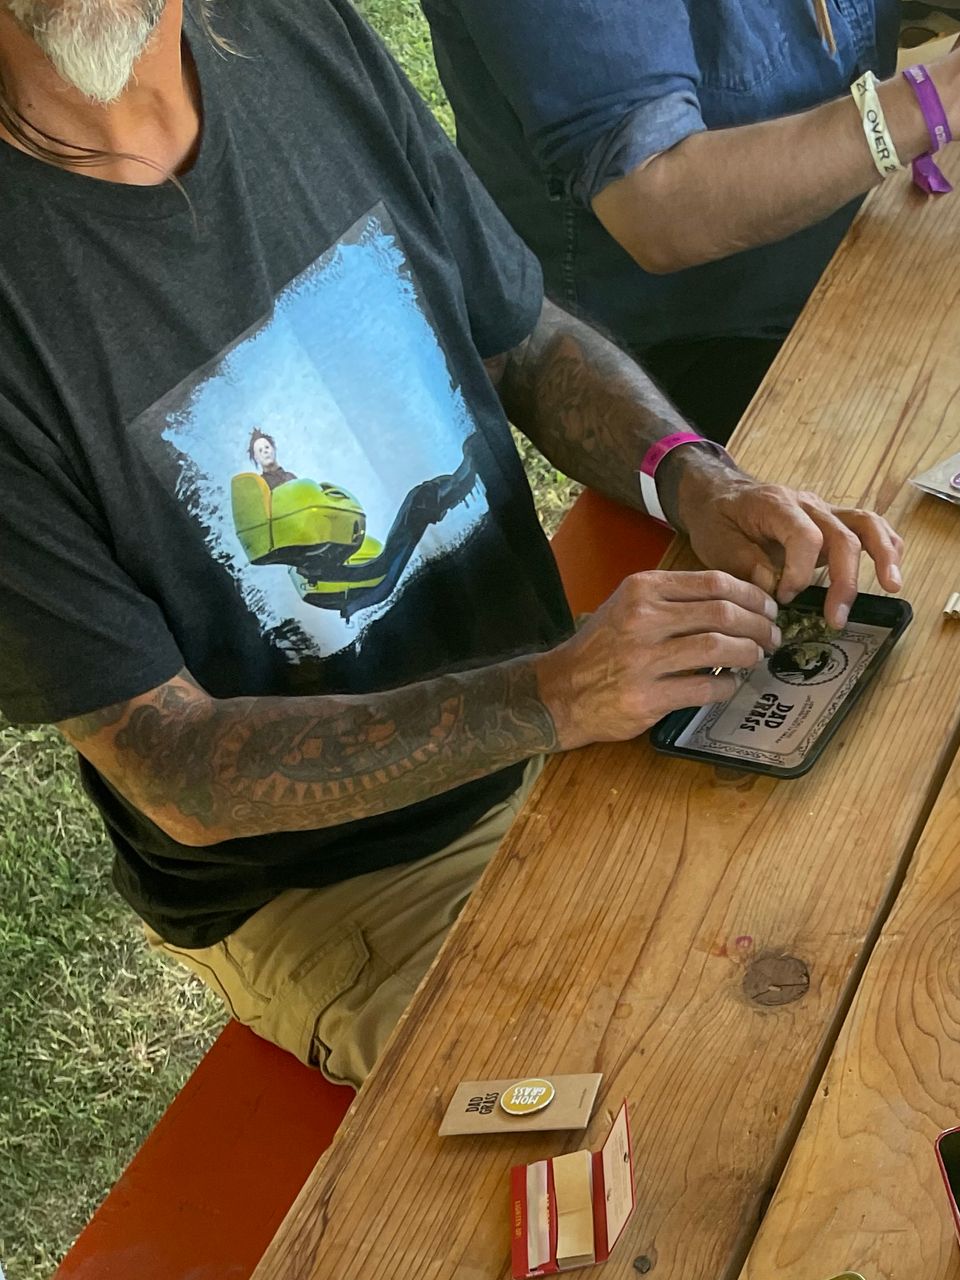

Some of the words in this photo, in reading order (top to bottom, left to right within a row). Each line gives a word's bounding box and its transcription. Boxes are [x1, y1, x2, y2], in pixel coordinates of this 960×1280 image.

[865, 109, 891, 160] OVER
[884, 163, 896, 173] 2
[740, 694, 778, 731] GRASS
[764, 702, 794, 729] DAD
[511, 1095, 540, 1104] MOM
[513, 1086, 546, 1096] GRASS
[465, 1096, 482, 1112] DAD
[480, 1092, 499, 1114] GRASS
